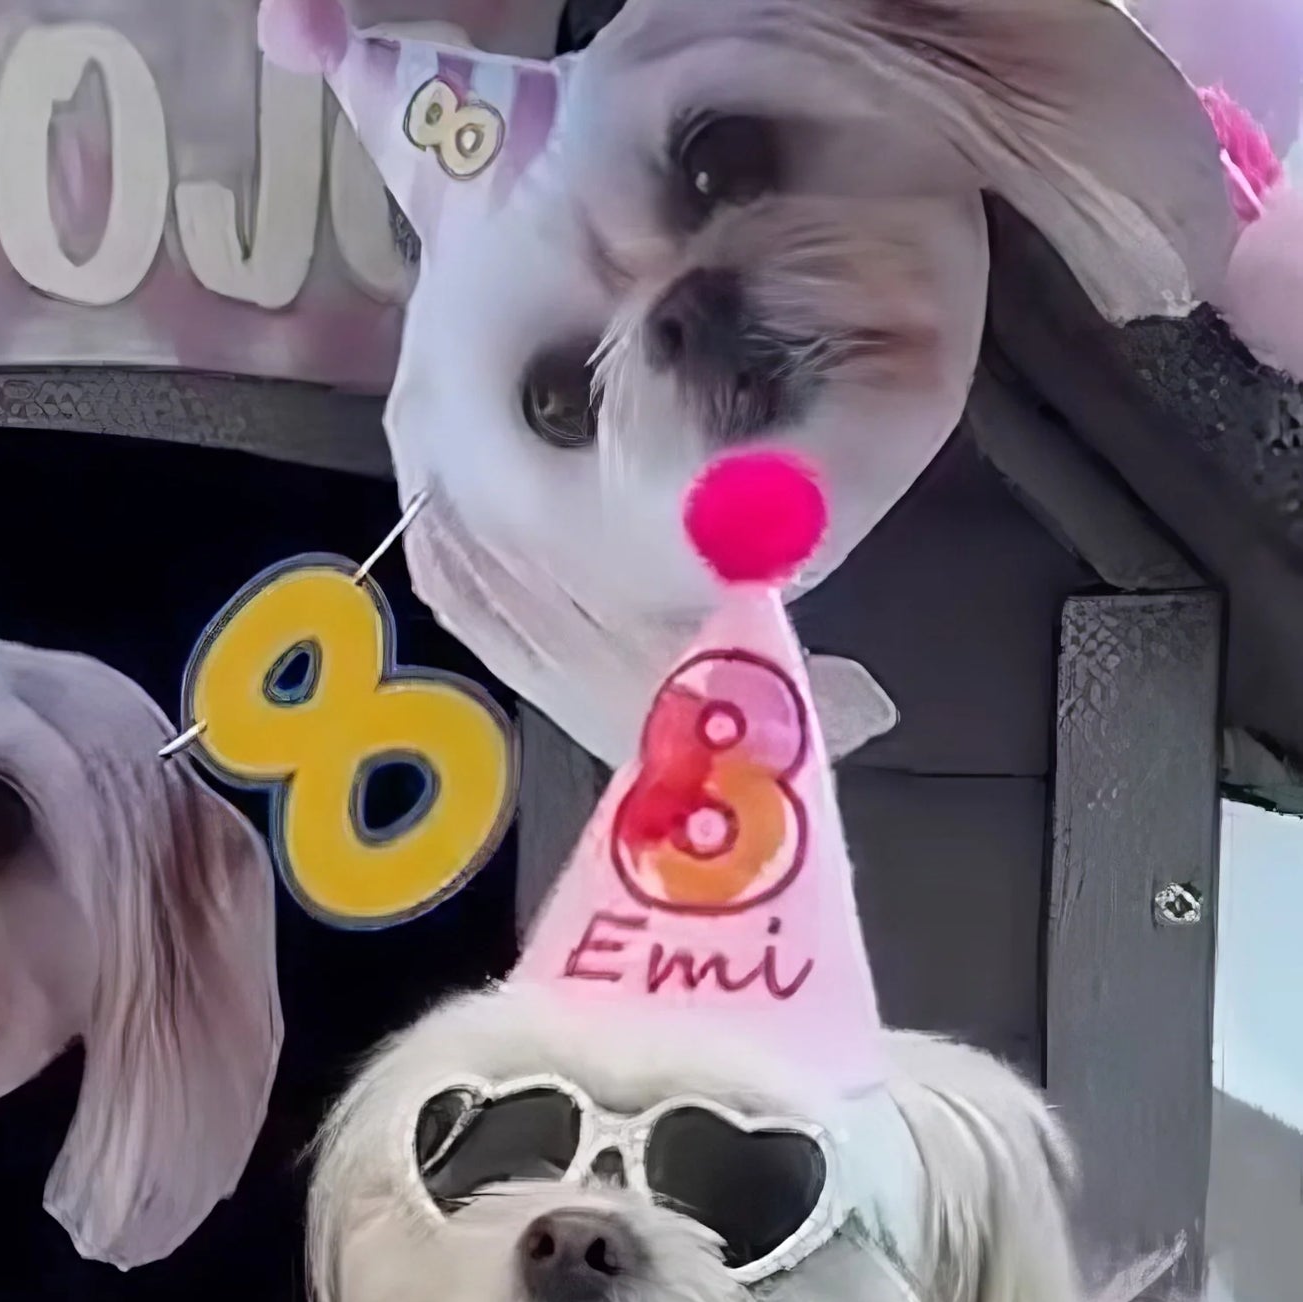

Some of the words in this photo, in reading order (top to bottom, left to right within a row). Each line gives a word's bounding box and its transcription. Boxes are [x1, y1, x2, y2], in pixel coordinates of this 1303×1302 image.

[403, 75, 506, 181] 8
[182, 553, 521, 930] 8
[611, 647, 809, 917] 8
[564, 911, 815, 1000] Emi
